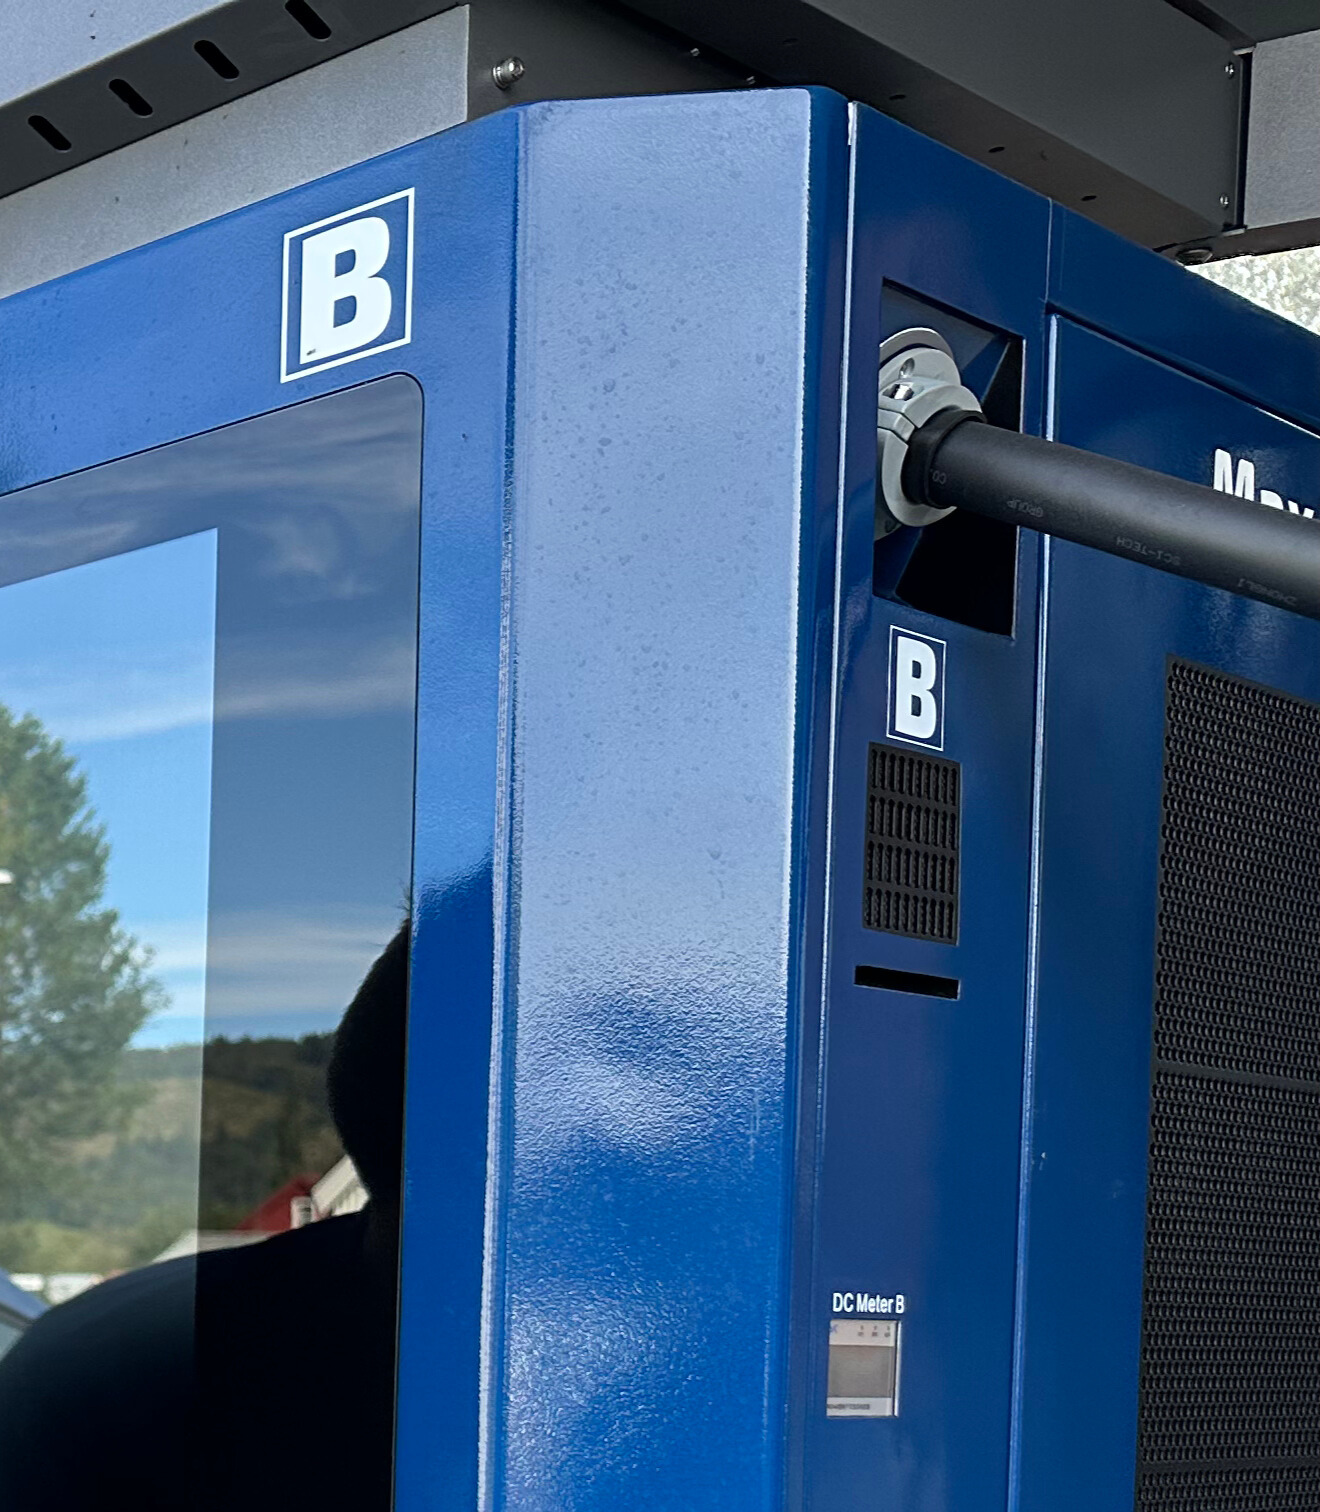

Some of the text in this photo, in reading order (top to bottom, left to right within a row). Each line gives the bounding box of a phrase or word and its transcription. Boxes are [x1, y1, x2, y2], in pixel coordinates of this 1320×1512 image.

[299, 216, 392, 365] B
[895, 636, 937, 739] B
[832, 1292, 905, 1314] DC Meter B
